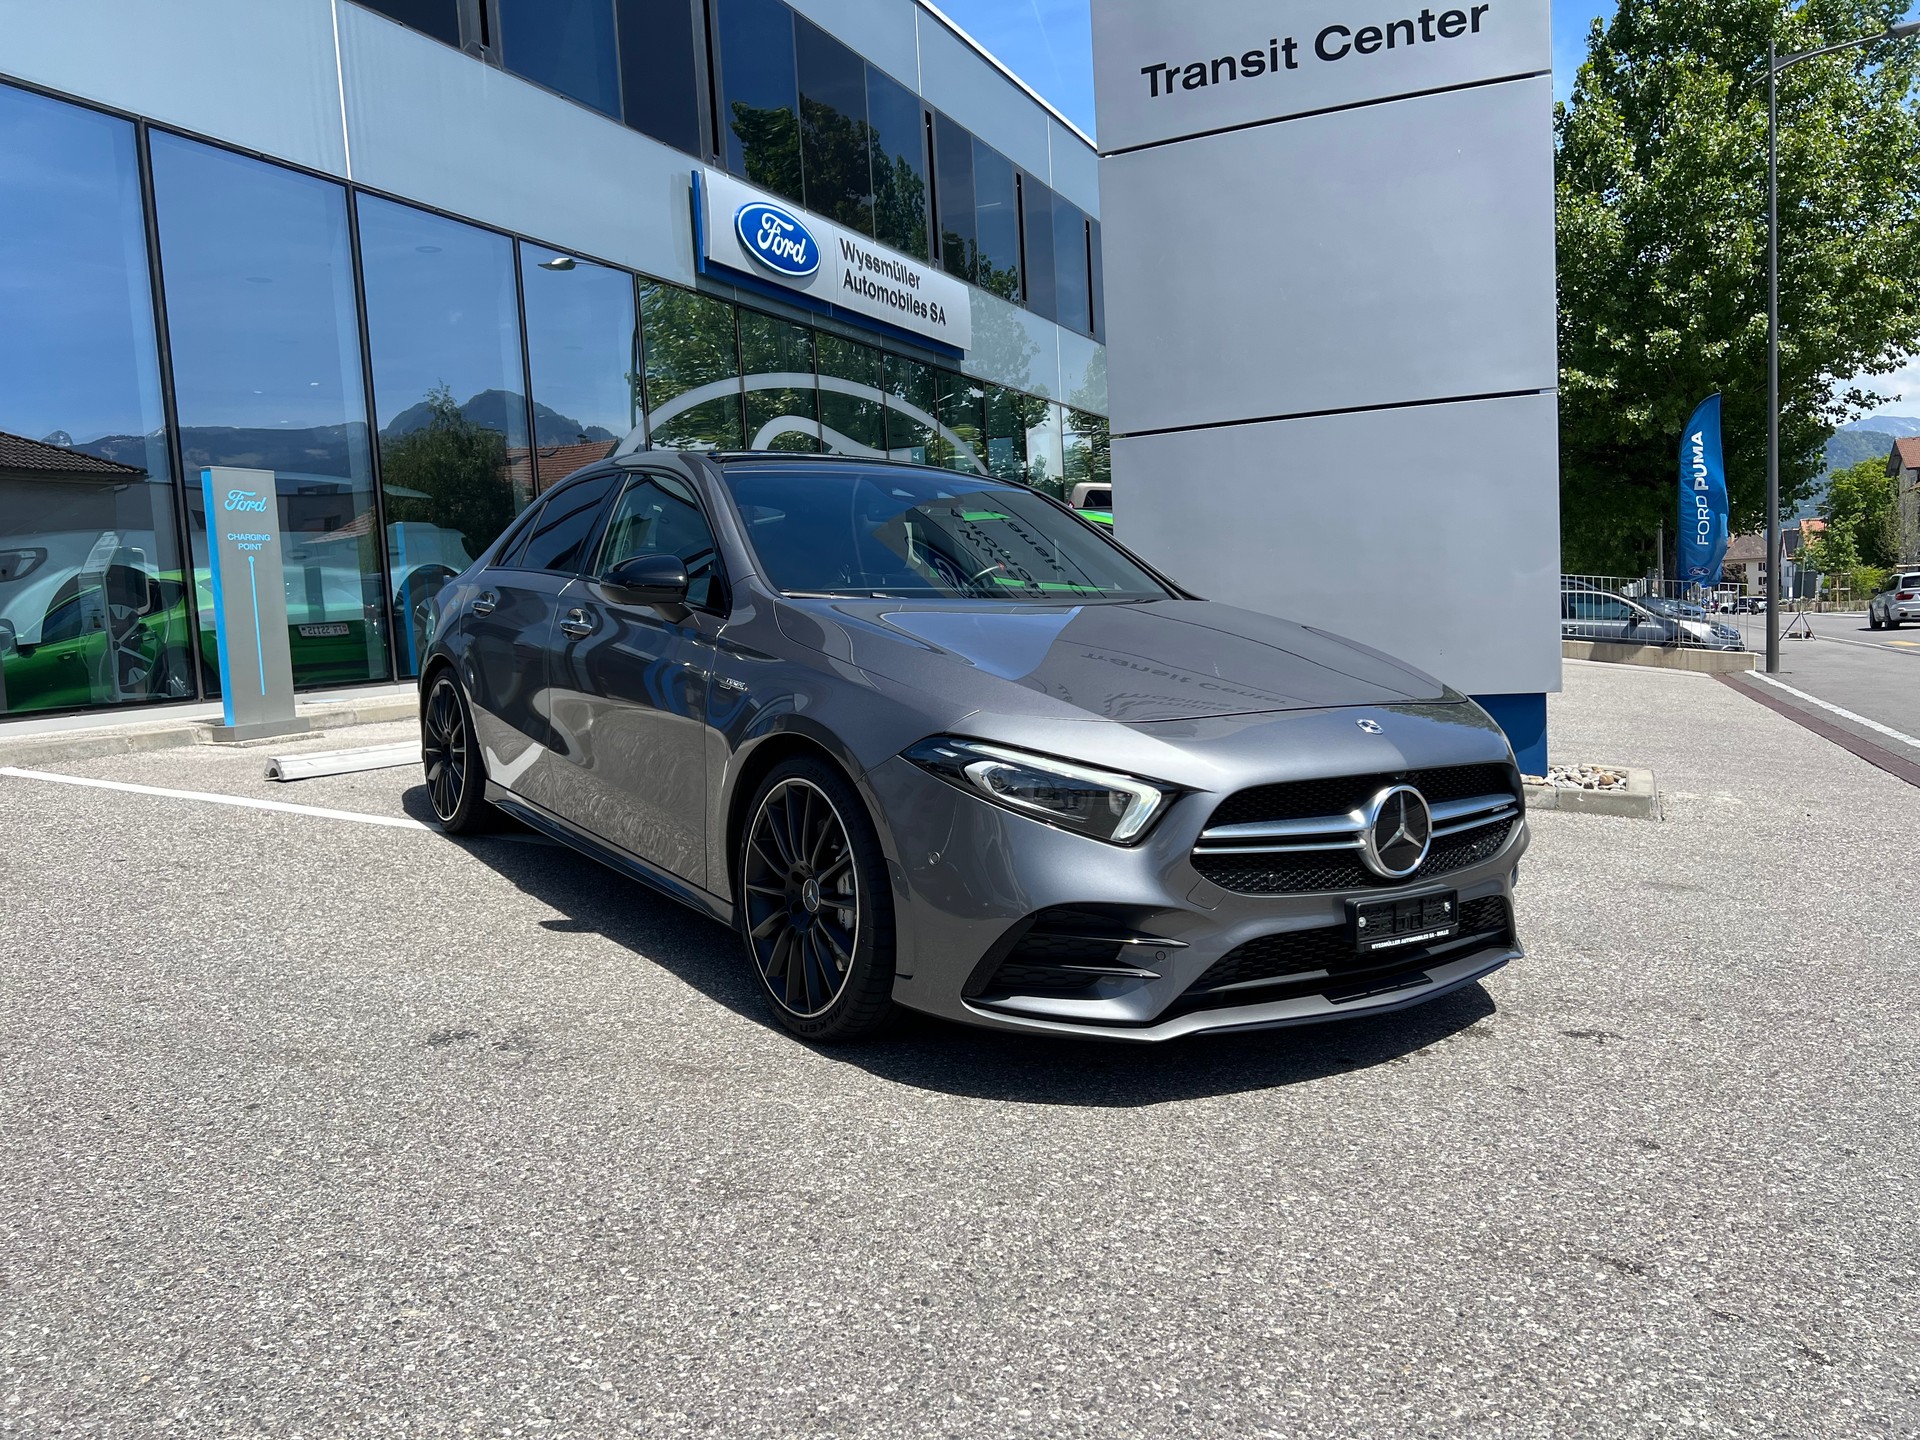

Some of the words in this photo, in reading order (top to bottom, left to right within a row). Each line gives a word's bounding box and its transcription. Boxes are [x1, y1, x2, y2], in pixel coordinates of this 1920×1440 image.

[1141, 37, 1298, 98] Transit
[1314, 3, 1490, 62] Center
[757, 212, 806, 265] Ford
[839, 237, 921, 290] Wyssmüller
[843, 268, 928, 319] Automobiles
[930, 301, 946, 327] SA
[1691, 430, 1709, 491] PUMA
[224, 489, 268, 513] Ford
[1696, 495, 1710, 545] FORD
[227, 533, 271, 542] CHARGING
[238, 543, 262, 551] POINT
